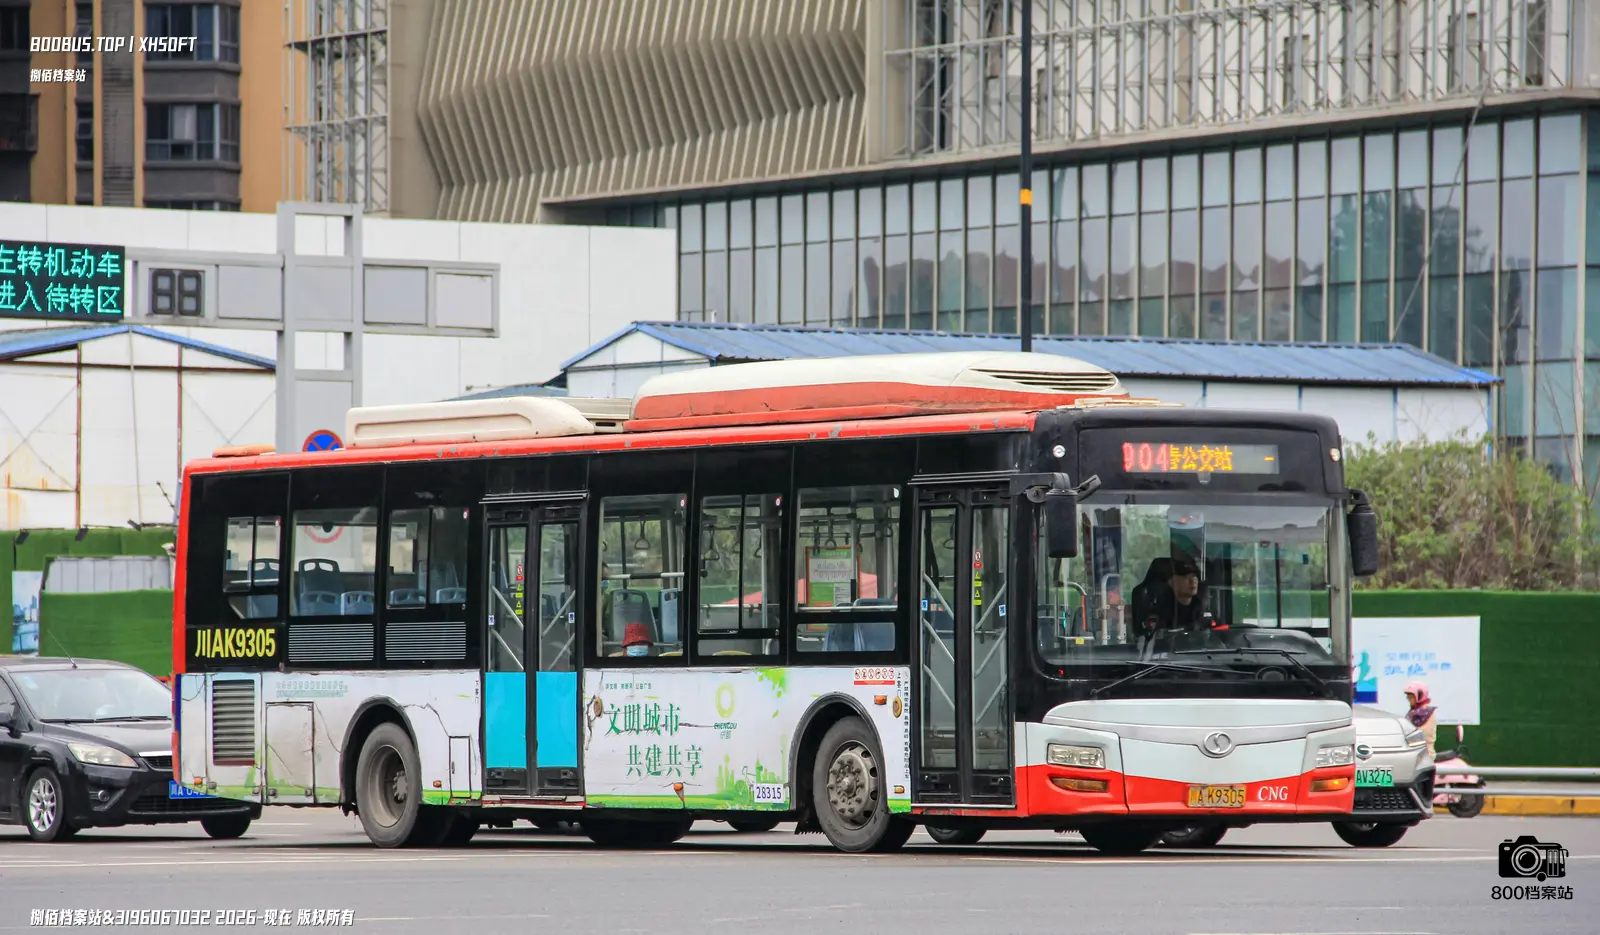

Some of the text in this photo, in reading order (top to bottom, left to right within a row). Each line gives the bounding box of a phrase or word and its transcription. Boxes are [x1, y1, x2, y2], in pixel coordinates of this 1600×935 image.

[0, 244, 121, 279] 左转机动车
[0, 281, 121, 314] 进入待转区
[1122, 442, 1169, 472] 904
[195, 628, 276, 658] 川AK9305
[604, 702, 680, 737] 文明城市
[626, 743, 703, 778] 共建共享
[1356, 769, 1393, 785] AV3275
[756, 786, 782, 800] 28315
[1257, 786, 1289, 801] CNG
